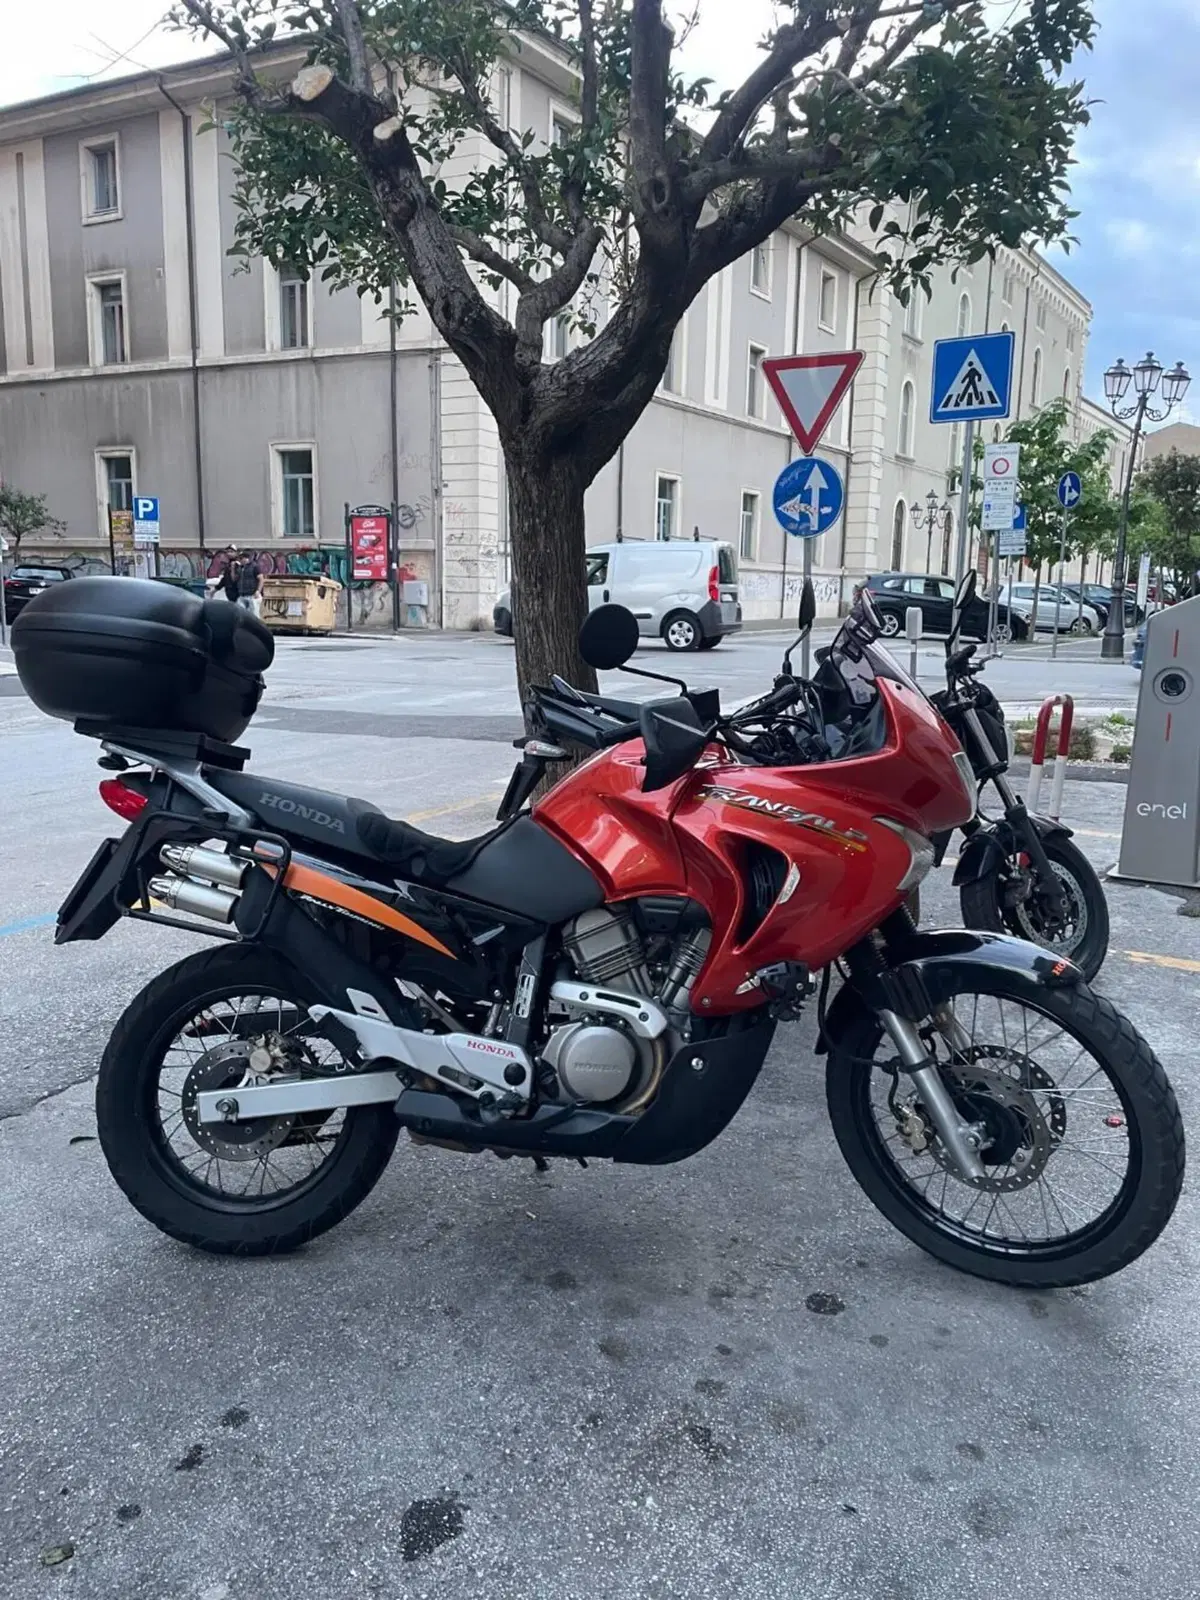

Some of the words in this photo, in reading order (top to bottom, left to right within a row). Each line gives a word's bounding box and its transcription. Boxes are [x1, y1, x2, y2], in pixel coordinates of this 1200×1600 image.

[138, 499, 154, 519] P
[259, 791, 345, 835] HONDA
[698, 783, 868, 841] TRANSALP
[1136, 802, 1187, 819] enel
[466, 1040, 516, 1059] HONDA
